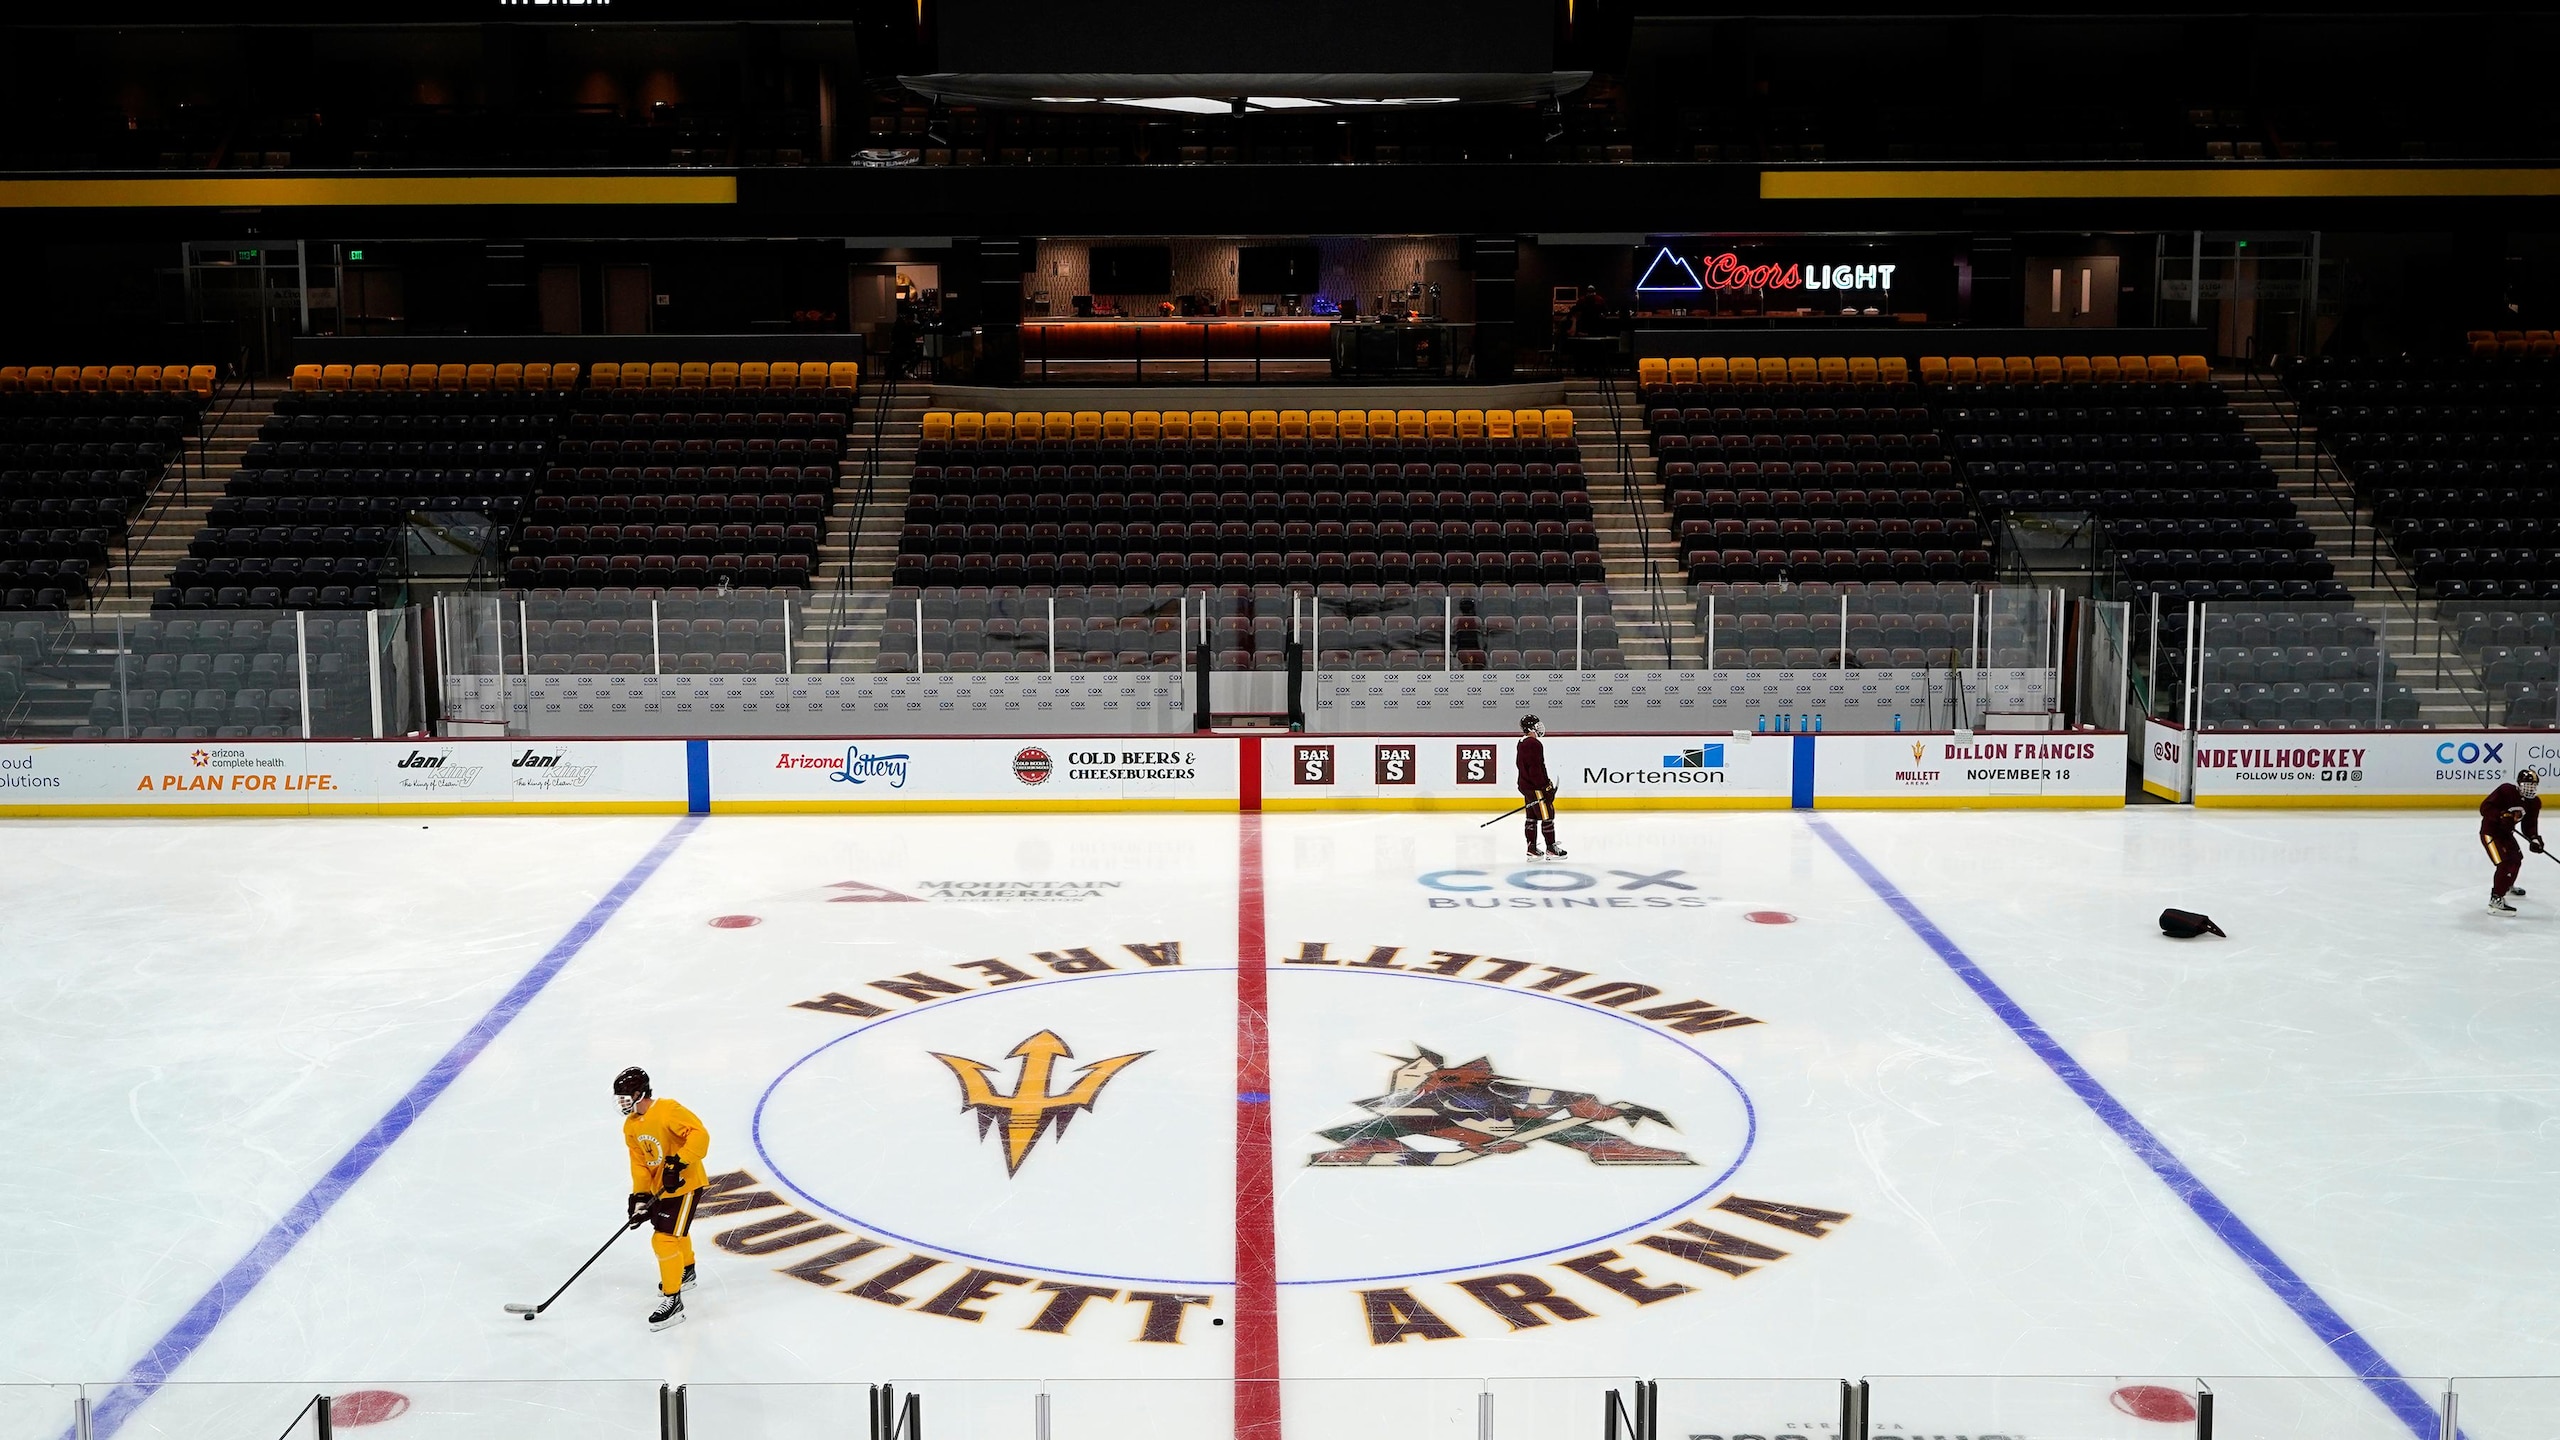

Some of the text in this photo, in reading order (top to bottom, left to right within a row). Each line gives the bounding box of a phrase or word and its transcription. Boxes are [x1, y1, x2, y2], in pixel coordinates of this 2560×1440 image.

[1704, 253, 1896, 289] Coors LIGHT
[211, 749, 246, 759] arizona
[397, 749, 447, 768] Jani
[512, 749, 562, 768] Jani
[1068, 752, 1196, 765] COLD BEERS &
[1299, 750, 1329, 761] BAR
[1381, 750, 1411, 761] BAR
[1462, 749, 1492, 760] BAR
[1944, 743, 2095, 760] DILLON FRANCIS
[2153, 741, 2180, 764] @SU
[2436, 742, 2504, 764] COX
[2, 755, 32, 770] oud
[212, 758, 285, 770] complete health
[775, 745, 910, 788] Arizona Lottery
[1468, 760, 1485, 780] S
[428, 763, 483, 787] king
[542, 762, 597, 787] king
[1069, 769, 1195, 780] CHEESEBURGERS
[1306, 761, 1323, 781] S
[1387, 761, 1404, 781] S
[1584, 767, 1724, 784] Mortenson
[1895, 771, 1940, 781] MULLETT
[1967, 770, 2071, 781] NOVEMBER 18
[2236, 772, 2315, 781] FOLLOW US ON:
[2436, 770, 2502, 780] BUSINESS
[137, 775, 339, 791] A PLAN FOR LIFE.
[917, 881, 1125, 889] MOUNTAIN
[1417, 869, 1698, 892] COX
[929, 889, 1105, 898] AMERICA
[1428, 897, 1707, 909] BUSINESS
[788, 941, 1767, 1036] MULLETT ARENA
[693, 1168, 1855, 1347] MULLETT ARENA
[1786, 1422, 1904, 1430] CERZA
